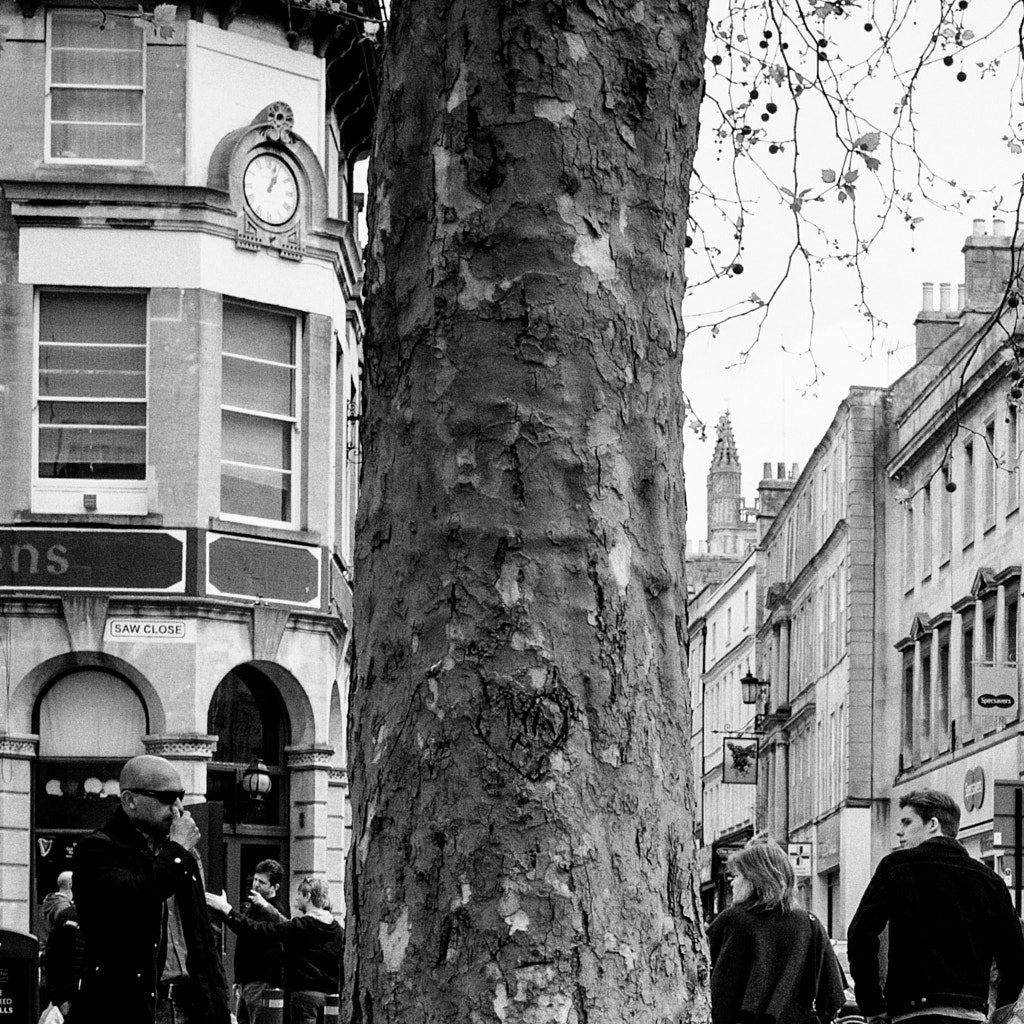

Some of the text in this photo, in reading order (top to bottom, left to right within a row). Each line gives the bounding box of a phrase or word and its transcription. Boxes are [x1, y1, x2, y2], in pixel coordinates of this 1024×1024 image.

[0, 542, 70, 575] ns
[114, 624, 183, 635] SAW CLOSE
